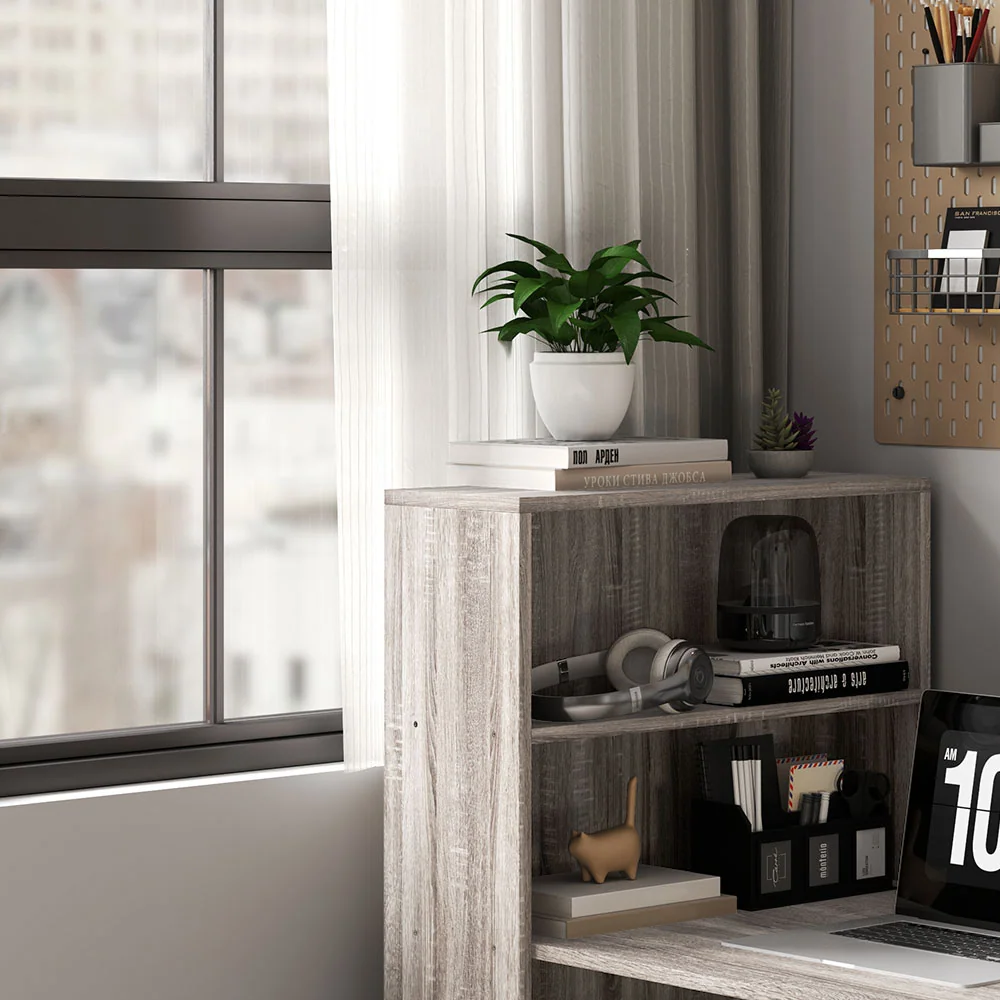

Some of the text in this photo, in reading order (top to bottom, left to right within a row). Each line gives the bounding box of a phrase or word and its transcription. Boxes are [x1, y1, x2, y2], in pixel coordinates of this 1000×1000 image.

[573, 448, 619, 465] ПОЛ АРДЕН
[584, 470, 706, 488] УРОКИ СТИВА ДЖОБСА
[770, 660, 807, 669] Architects
[827, 653, 878, 665] Conversations
[788, 674, 838, 694] architecture
[851, 671, 867, 689] arts
[944, 748, 958, 761] AM
